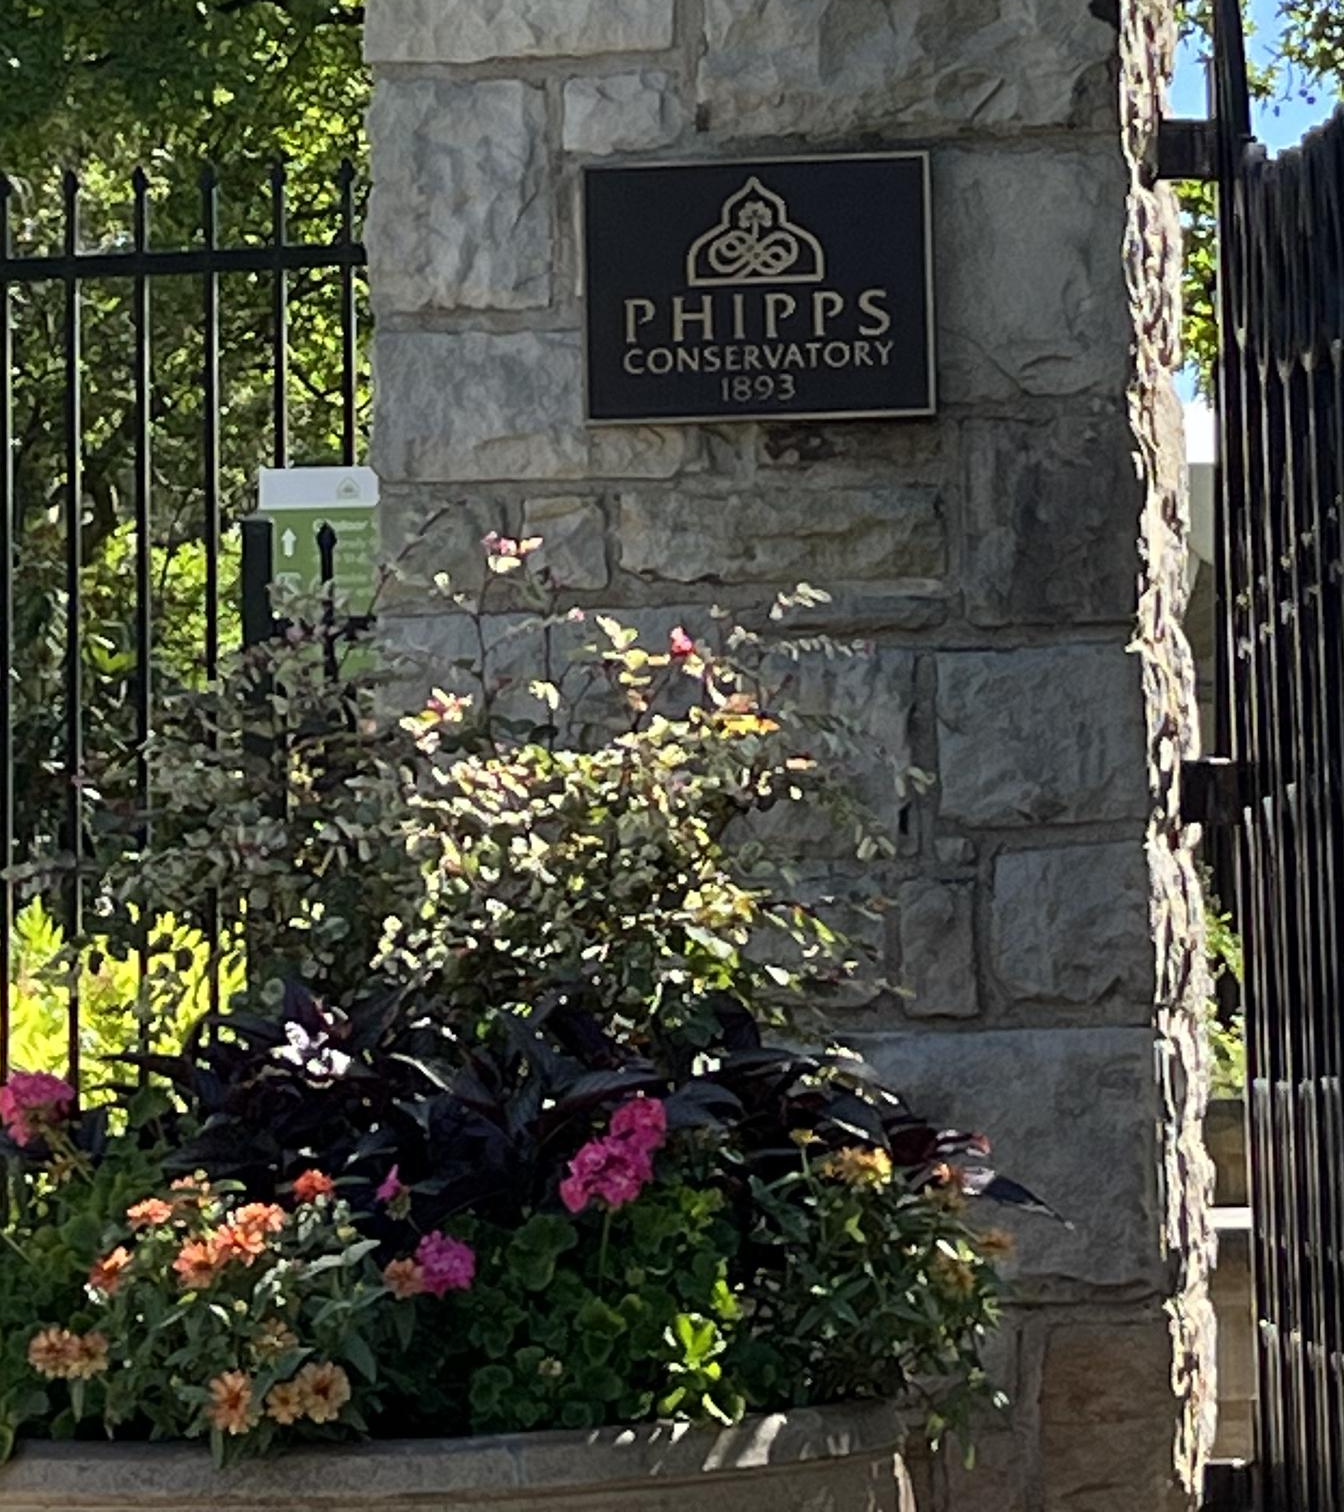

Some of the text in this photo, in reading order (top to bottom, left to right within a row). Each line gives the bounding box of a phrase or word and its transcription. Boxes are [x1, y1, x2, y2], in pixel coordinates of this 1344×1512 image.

[623, 289, 891, 344] PHIPPS
[622, 340, 894, 375] CONSERVATORY
[720, 374, 796, 402] 1893
